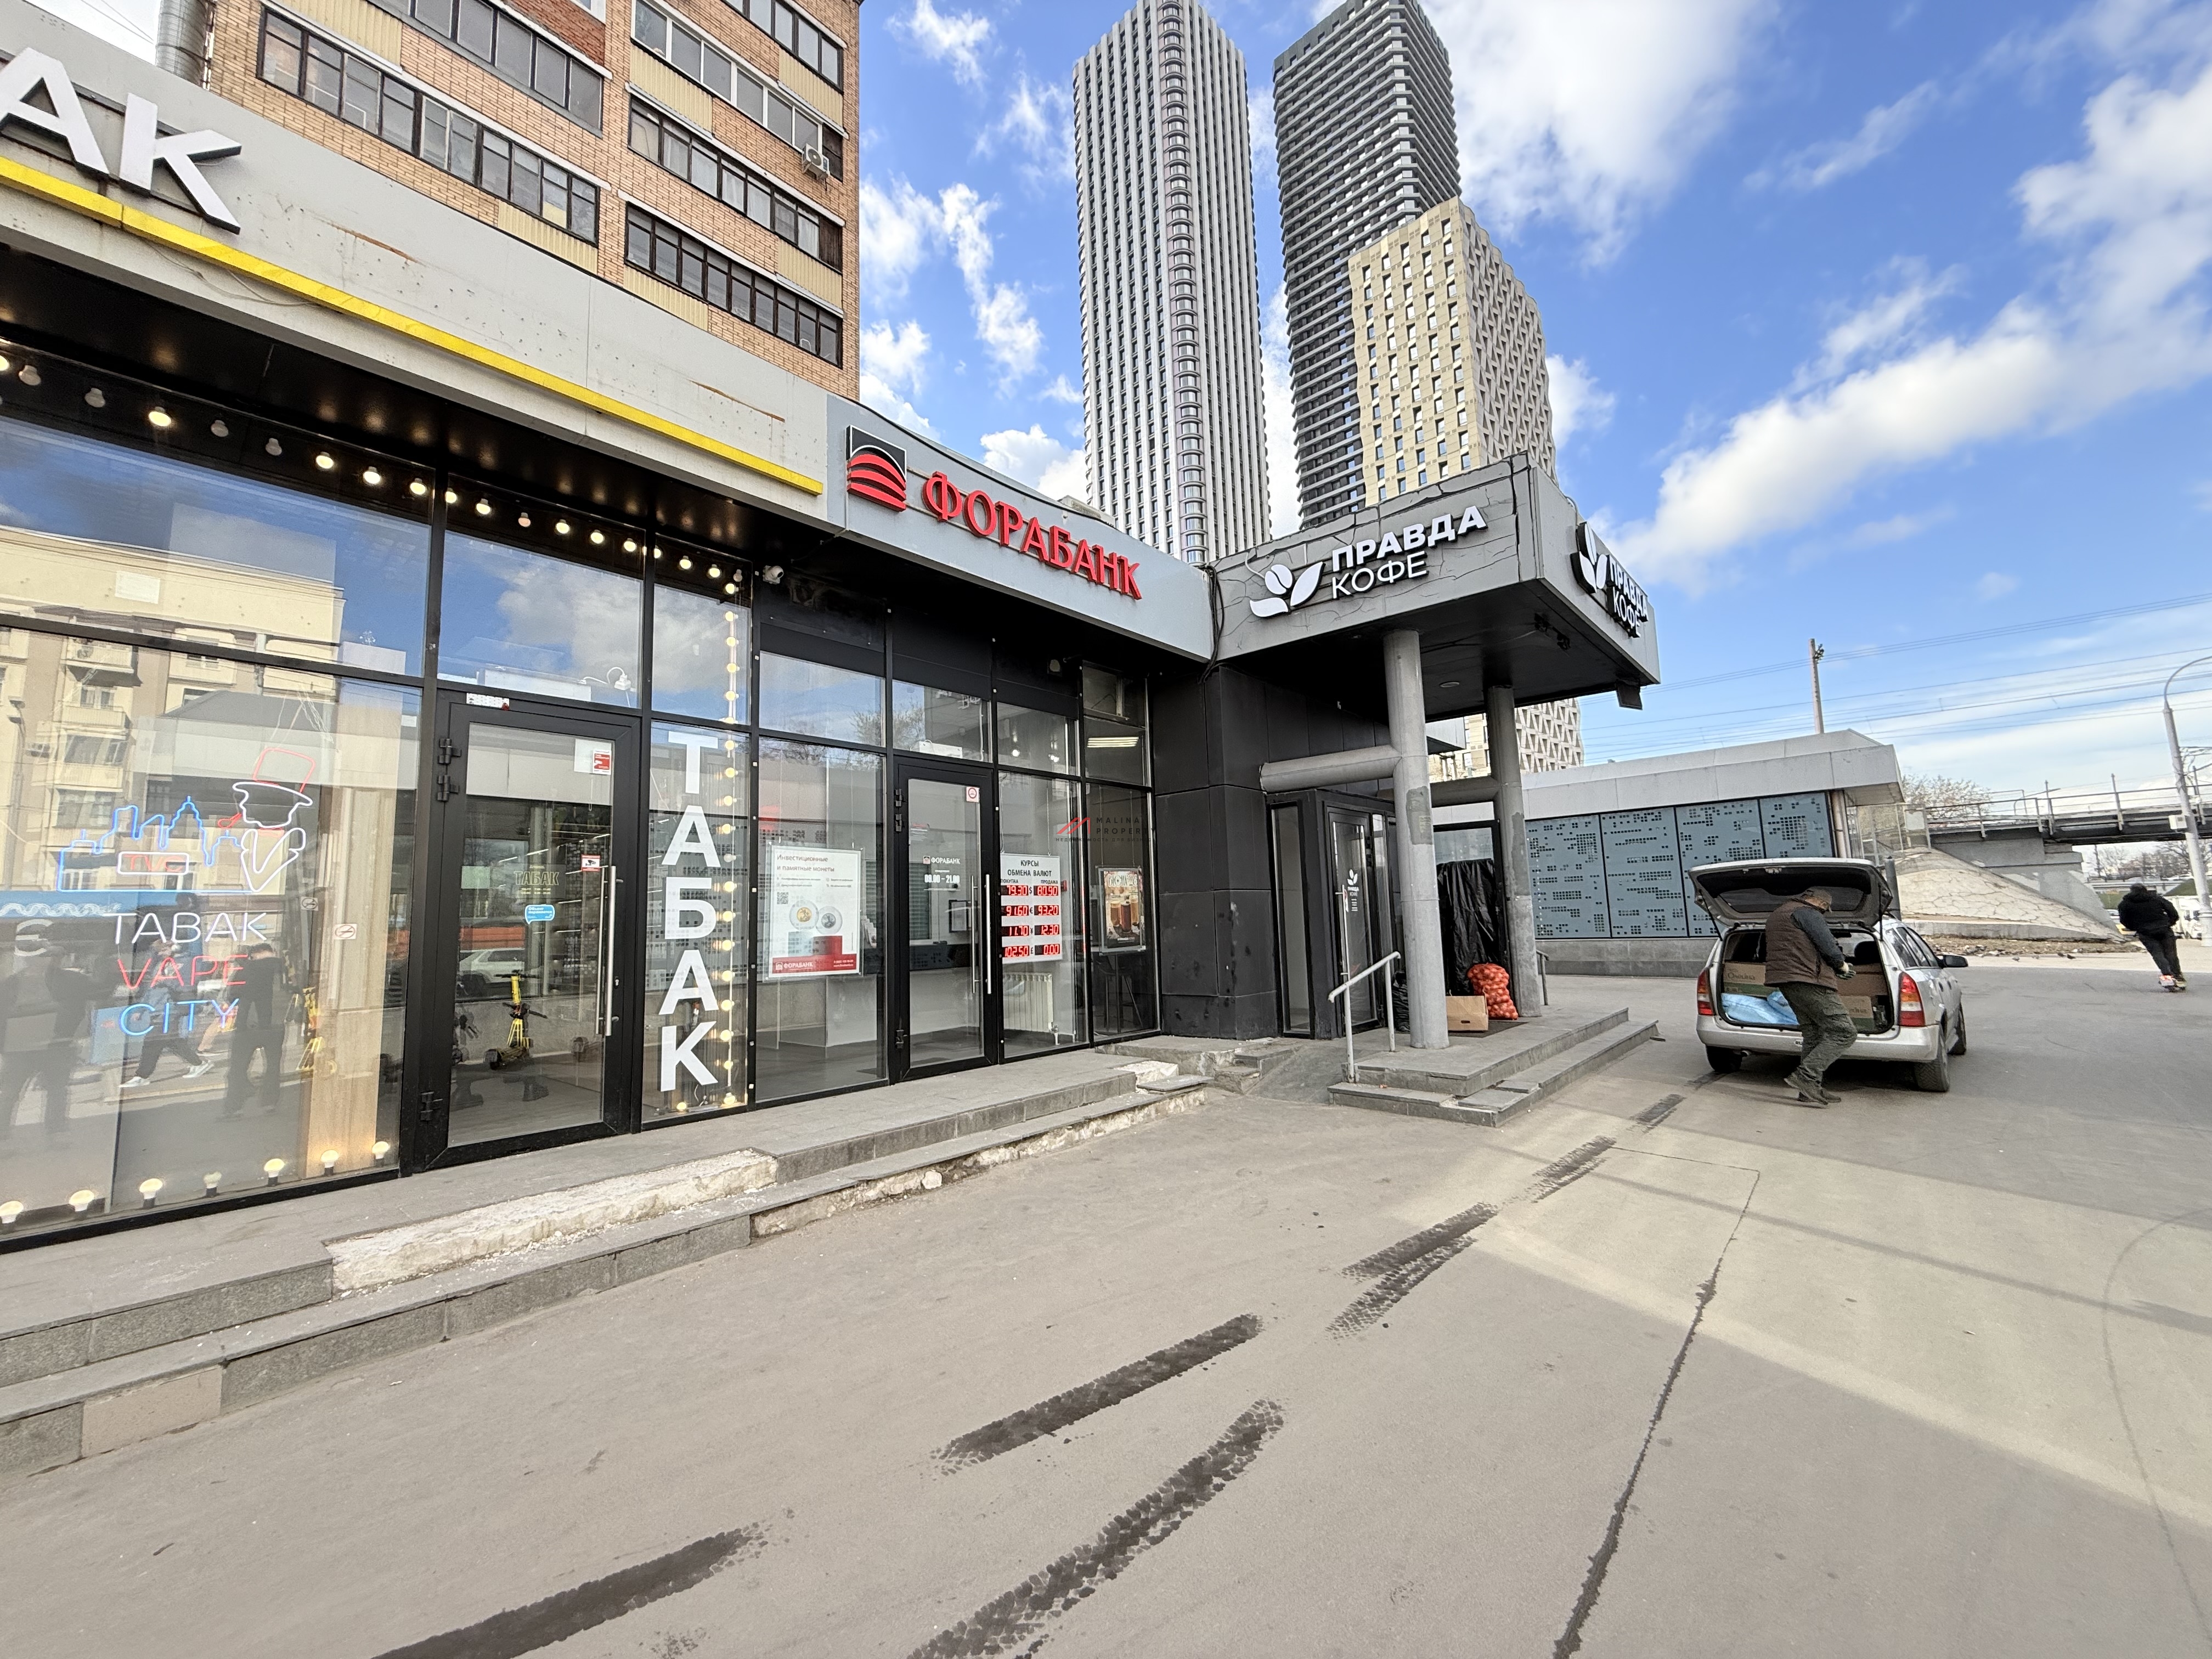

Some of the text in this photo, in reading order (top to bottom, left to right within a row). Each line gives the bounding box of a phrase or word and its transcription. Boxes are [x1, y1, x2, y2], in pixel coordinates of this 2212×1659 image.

[922, 471, 1142, 600] ФОРАБАНК
[1332, 505, 1487, 572] ПРАВДА
[1332, 550, 1427, 599] КОФЕ
[1609, 554, 1649, 622] ПРАВДА
[1612, 586, 1641, 638] КОФЕ
[514, 871, 560, 885] ТАБАК
[103, 912, 267, 944] TABAK
[658, 731, 721, 1092] ТАБАК
[117, 953, 249, 990] VAPE
[1005, 946, 1029, 957] 102.50
[120, 998, 239, 1036] CITY
